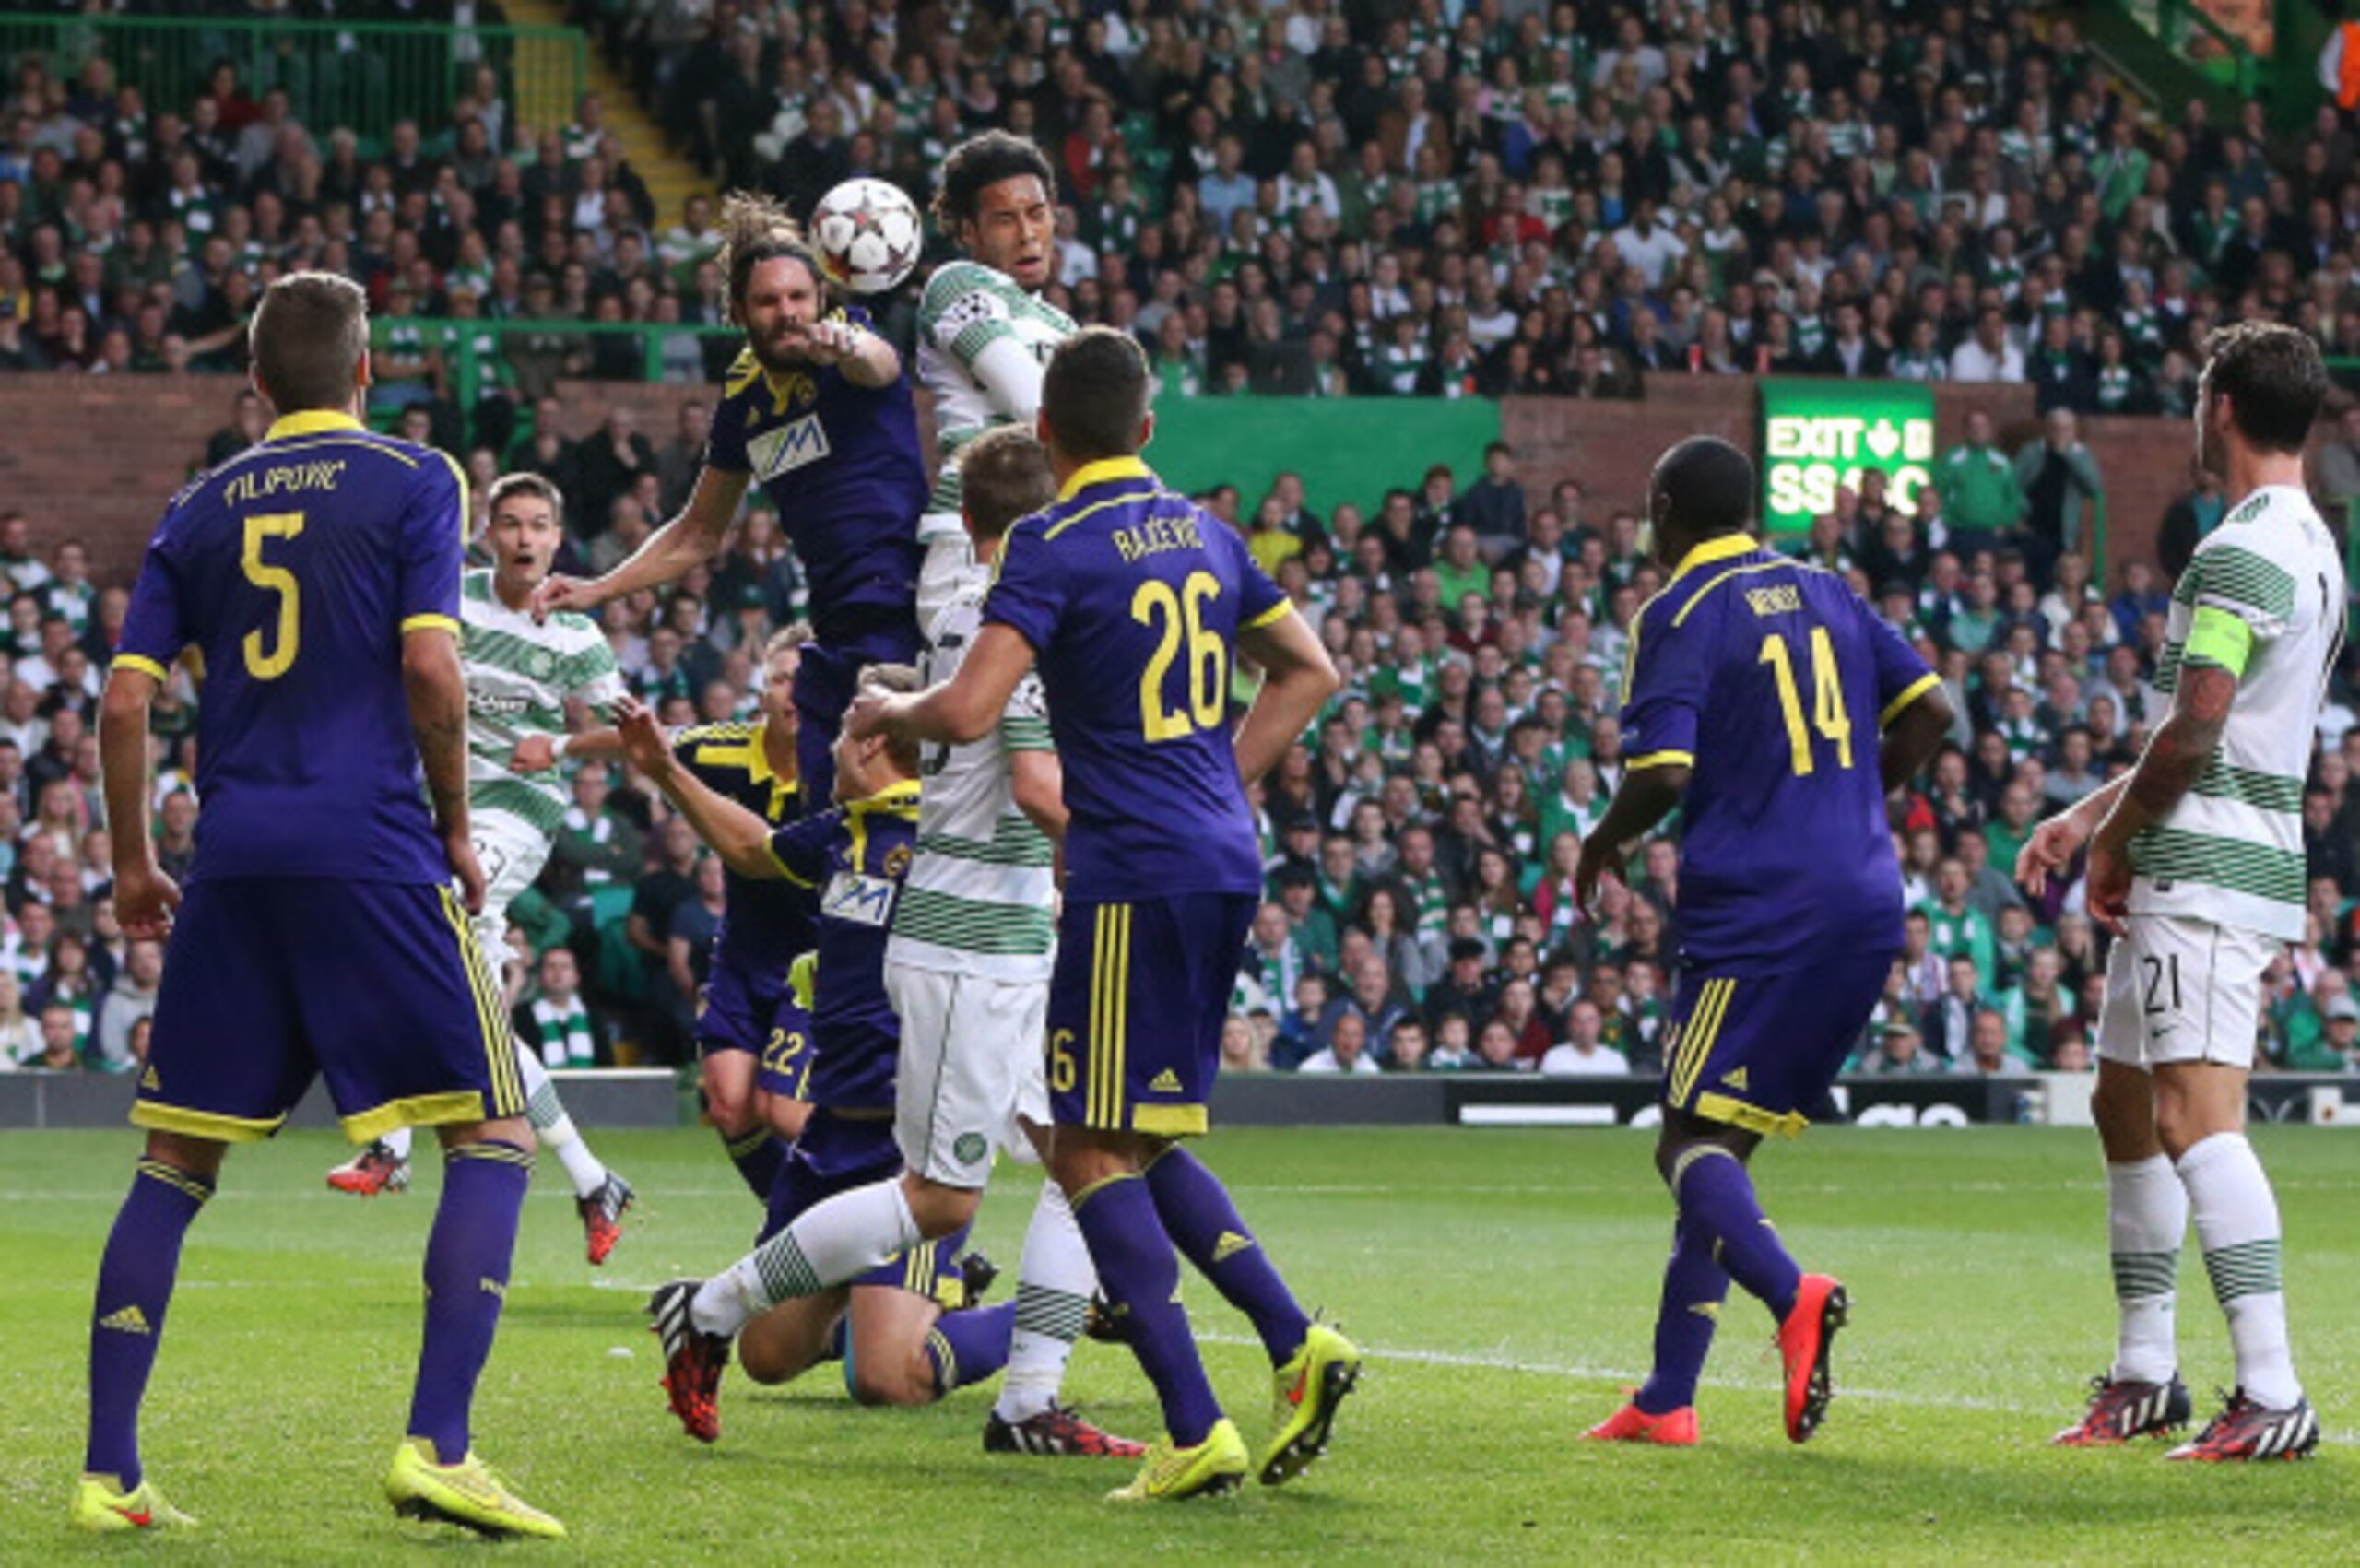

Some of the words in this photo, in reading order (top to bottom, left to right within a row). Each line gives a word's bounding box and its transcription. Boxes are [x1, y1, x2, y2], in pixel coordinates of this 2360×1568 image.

[1767, 416, 1863, 458] EXIT
[242, 511, 305, 680] 5
[1131, 571, 1227, 742] 26
[1758, 626, 1853, 776] 14
[2143, 953, 2181, 1013] 21
[762, 1027, 805, 1076] 22
